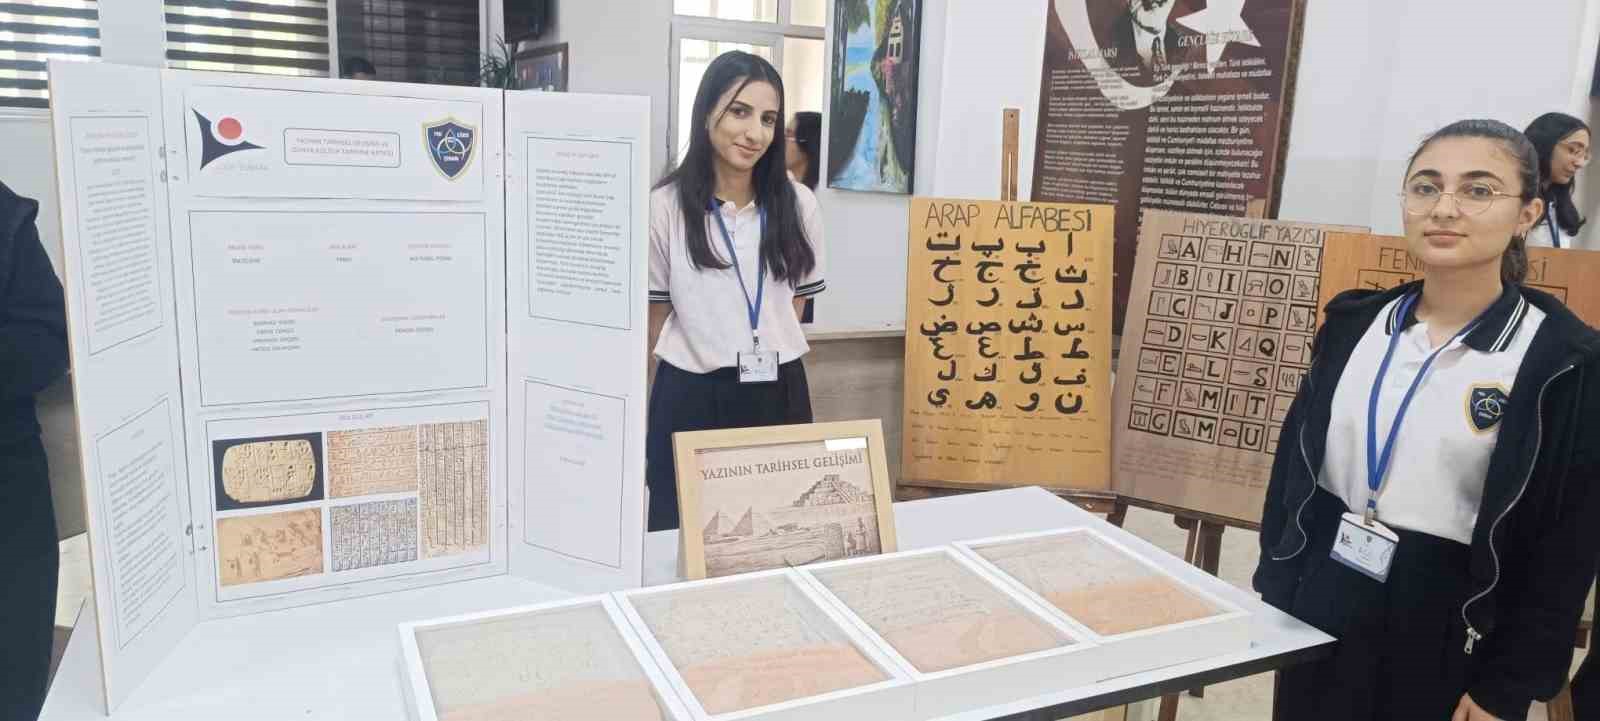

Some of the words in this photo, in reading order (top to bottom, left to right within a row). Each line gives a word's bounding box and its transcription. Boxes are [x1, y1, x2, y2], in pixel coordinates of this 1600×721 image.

[925, 202, 981, 229] ARAP
[926, 232, 961, 251] ت
[1015, 240, 1046, 257] ب
[1181, 241, 1196, 259] A
[1226, 245, 1242, 263] H
[1273, 249, 1290, 267] N
[1379, 247, 1424, 272] FEN
[1055, 265, 1088, 283] ث
[1178, 269, 1189, 286] B
[1225, 273, 1235, 292] I
[1269, 279, 1284, 294] O
[1008, 312, 1043, 333] ش
[1173, 298, 1187, 316] C
[1219, 303, 1234, 320] J
[1266, 307, 1278, 324] P
[920, 314, 959, 336] ض
[1053, 321, 1085, 336] س
[1168, 326, 1182, 343] D
[1210, 331, 1226, 350] K
[1258, 338, 1275, 357] Q
[1053, 368, 1087, 385] ف
[1162, 355, 1177, 372] E
[1207, 360, 1220, 377] L
[1253, 367, 1268, 387] S
[1015, 392, 1040, 412] و
[1055, 392, 1083, 414] ن
[1157, 383, 1171, 401] F
[1201, 390, 1218, 409] M
[1251, 396, 1266, 415] T
[1152, 413, 1166, 430] G
[1197, 421, 1214, 439] M
[1244, 427, 1259, 446] U
[701, 463, 752, 480] YAZININ
[755, 457, 810, 475] TARİHSEL
